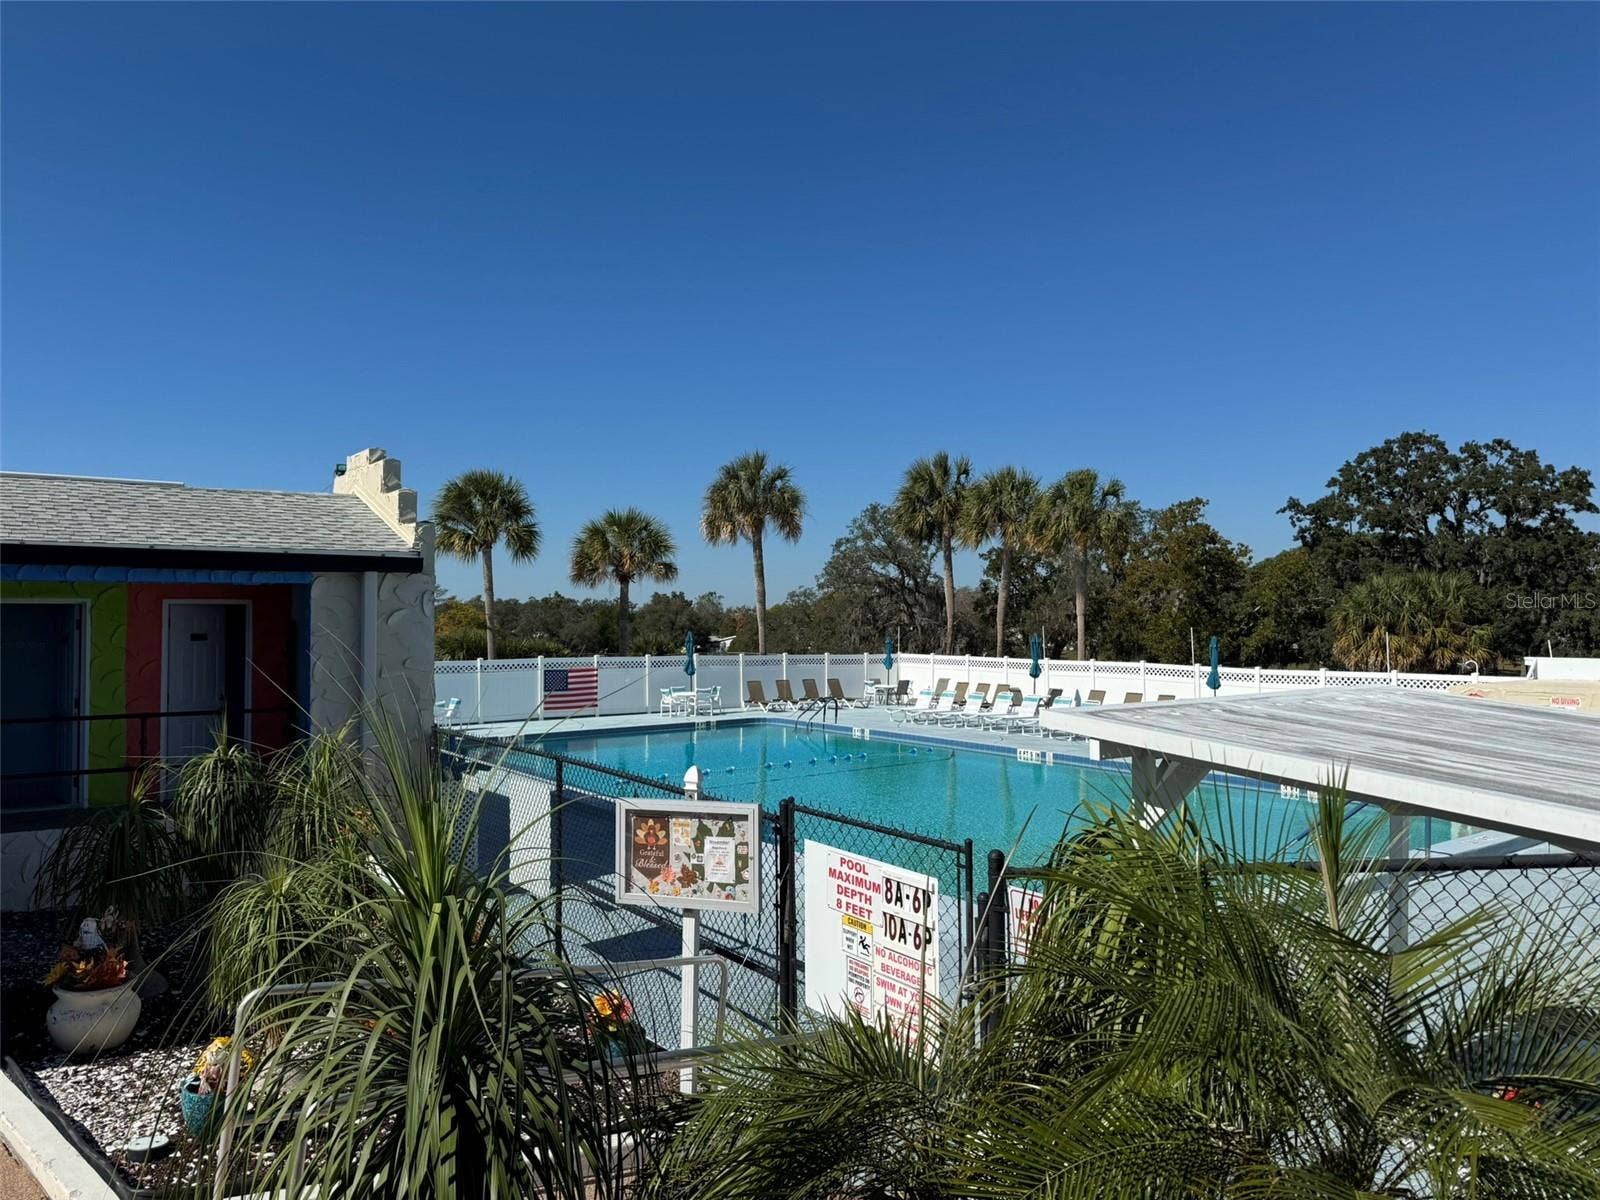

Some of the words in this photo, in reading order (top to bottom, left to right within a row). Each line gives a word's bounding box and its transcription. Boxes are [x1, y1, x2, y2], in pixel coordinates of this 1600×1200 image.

[840, 856, 869, 876] POOL
[828, 866, 882, 895] MAXIMUM
[836, 883, 873, 906] DEPTH
[836, 897, 843, 910] 8
[845, 901, 873, 920] FEET
[846, 916, 868, 931] CAUTION
[875, 946, 887, 959] NO
[888, 952, 933, 977] ALCOHOIC
[876, 976, 897, 992] SWIM
[898, 986, 908, 998] AT
[880, 962, 926, 989] BEVERAGE
[885, 995, 903, 1010] OWN
